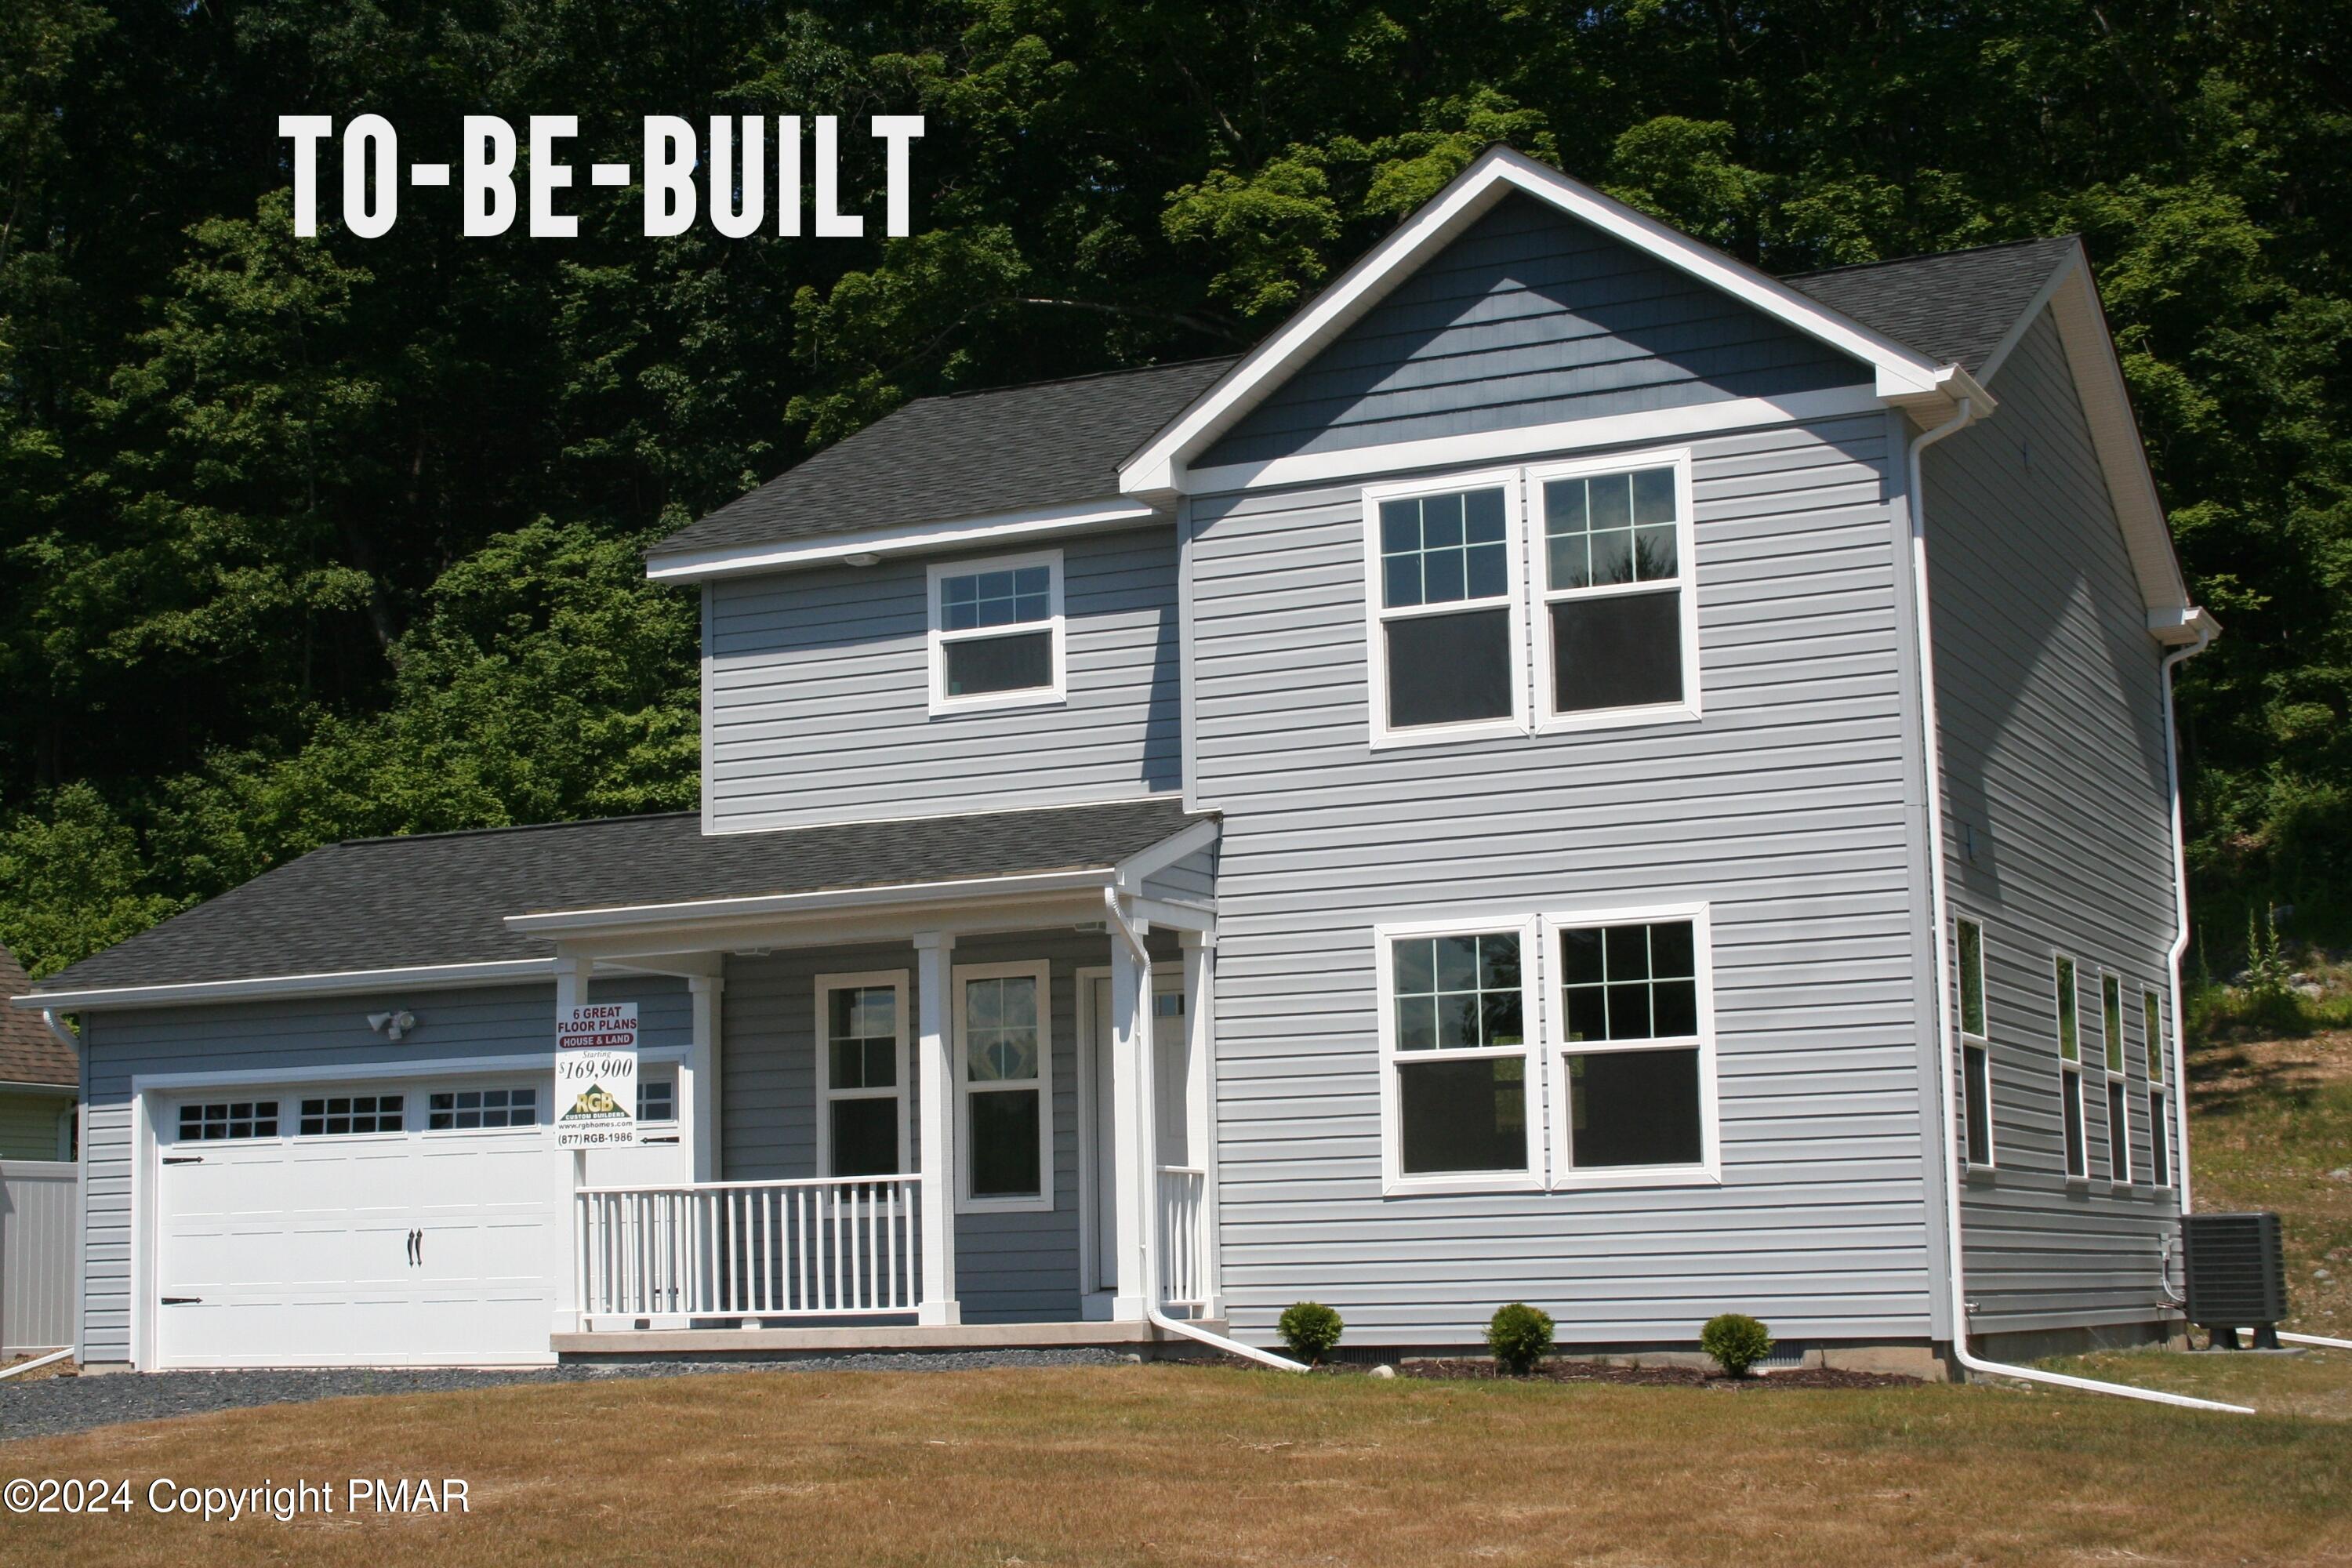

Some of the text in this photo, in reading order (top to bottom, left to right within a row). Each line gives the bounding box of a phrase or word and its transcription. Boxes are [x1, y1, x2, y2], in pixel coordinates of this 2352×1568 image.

[573, 1006, 622, 1020] 6 GREAT
[558, 1018, 637, 1033] FLOOR PLANS
[564, 1034, 630, 1047] HOUSE & LAND
[582, 1051, 612, 1059] Starting
[558, 1058, 633, 1080] $169,900
[576, 1092, 614, 1113] RGB
[558, 1121, 633, 1130] www.rgbhomes.com
